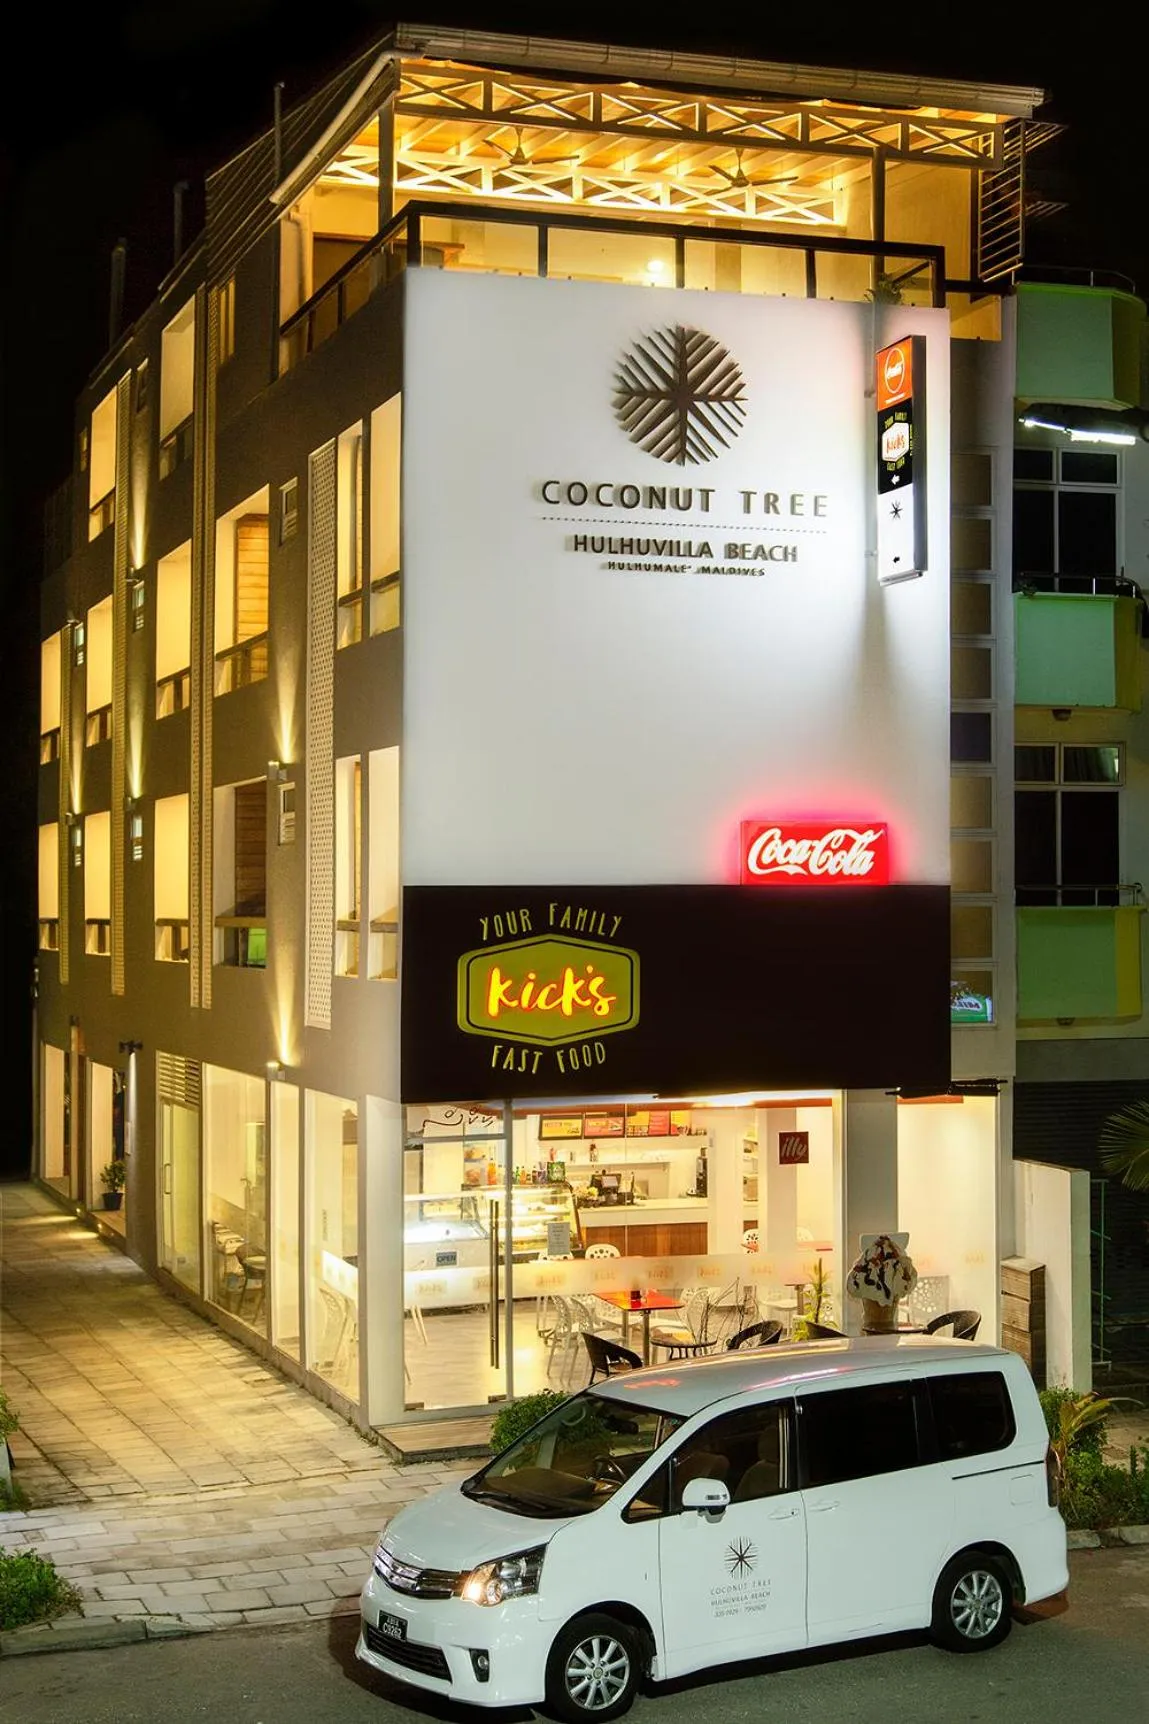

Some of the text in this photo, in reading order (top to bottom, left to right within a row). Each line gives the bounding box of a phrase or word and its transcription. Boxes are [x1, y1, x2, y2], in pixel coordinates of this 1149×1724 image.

[541, 480, 828, 518] COCONUT TREE
[572, 533, 799, 563] HULHUVILLA BEACH
[700, 565, 766, 577] MALDIVES
[747, 827, 884, 876] Coca-Cola
[479, 903, 622, 941] YOUR FAMILY
[486, 964, 617, 1018] kick's
[491, 1042, 606, 1074] FAST FOOD
[780, 1136, 808, 1160] illy
[437, 1254, 457, 1264] OPEN
